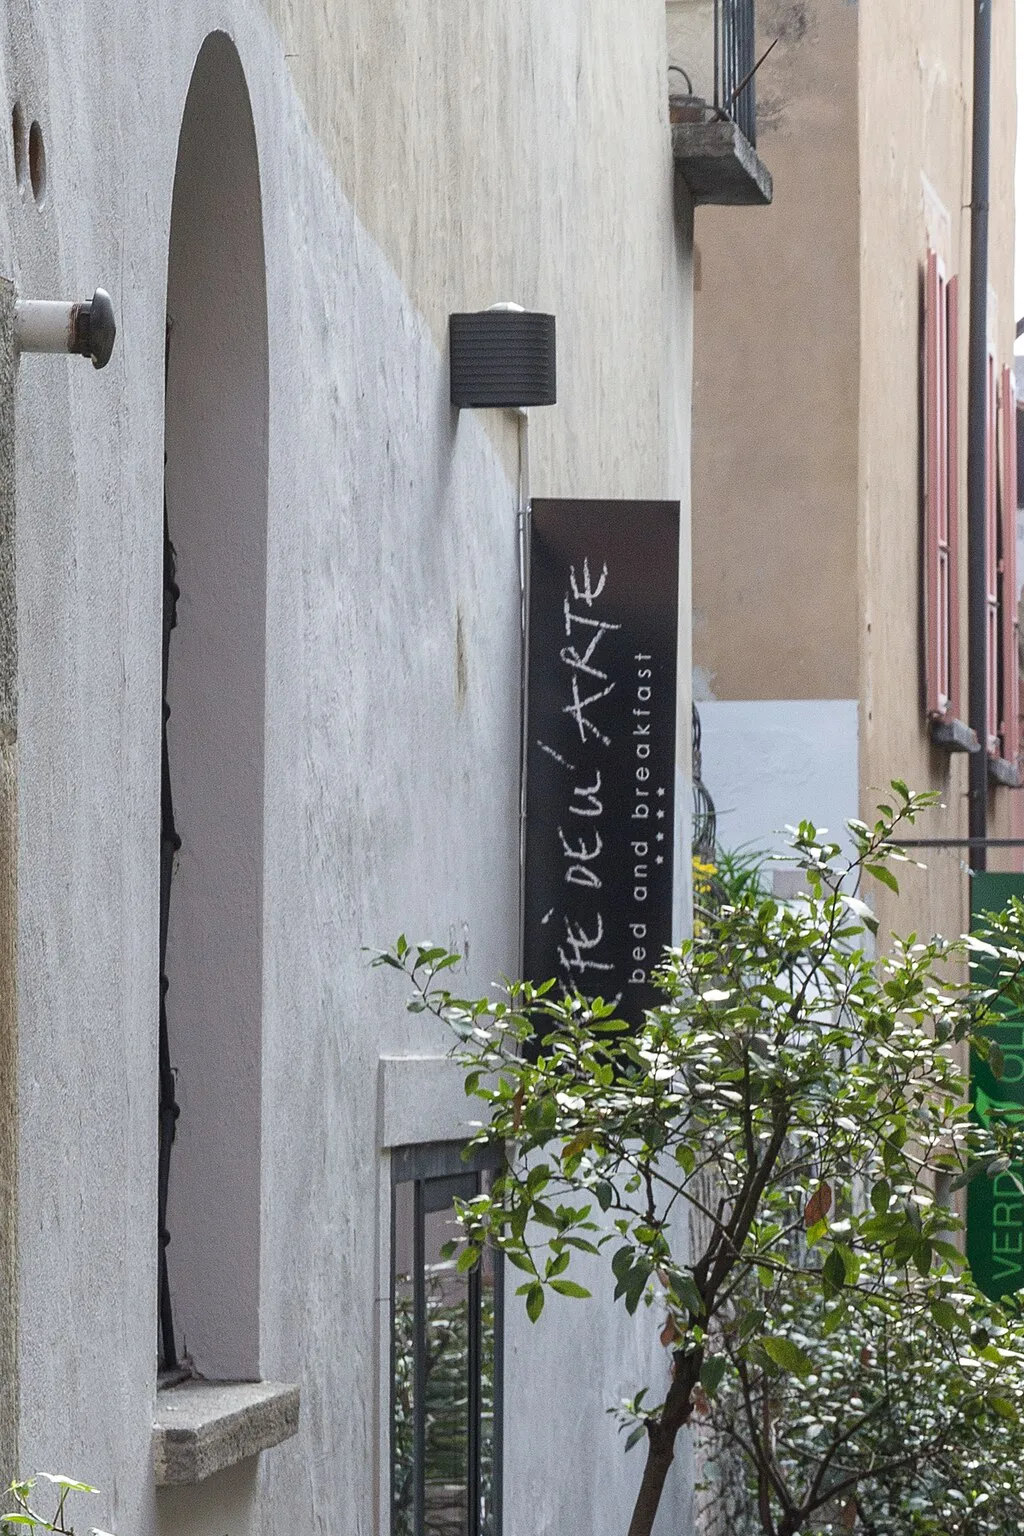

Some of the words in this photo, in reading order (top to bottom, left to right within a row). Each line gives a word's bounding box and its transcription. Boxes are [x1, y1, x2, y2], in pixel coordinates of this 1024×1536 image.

[632, 651, 653, 820] breakfast
[630, 840, 649, 902] and
[628, 921, 648, 984] bed
[991, 1148, 1023, 1281] VERD
